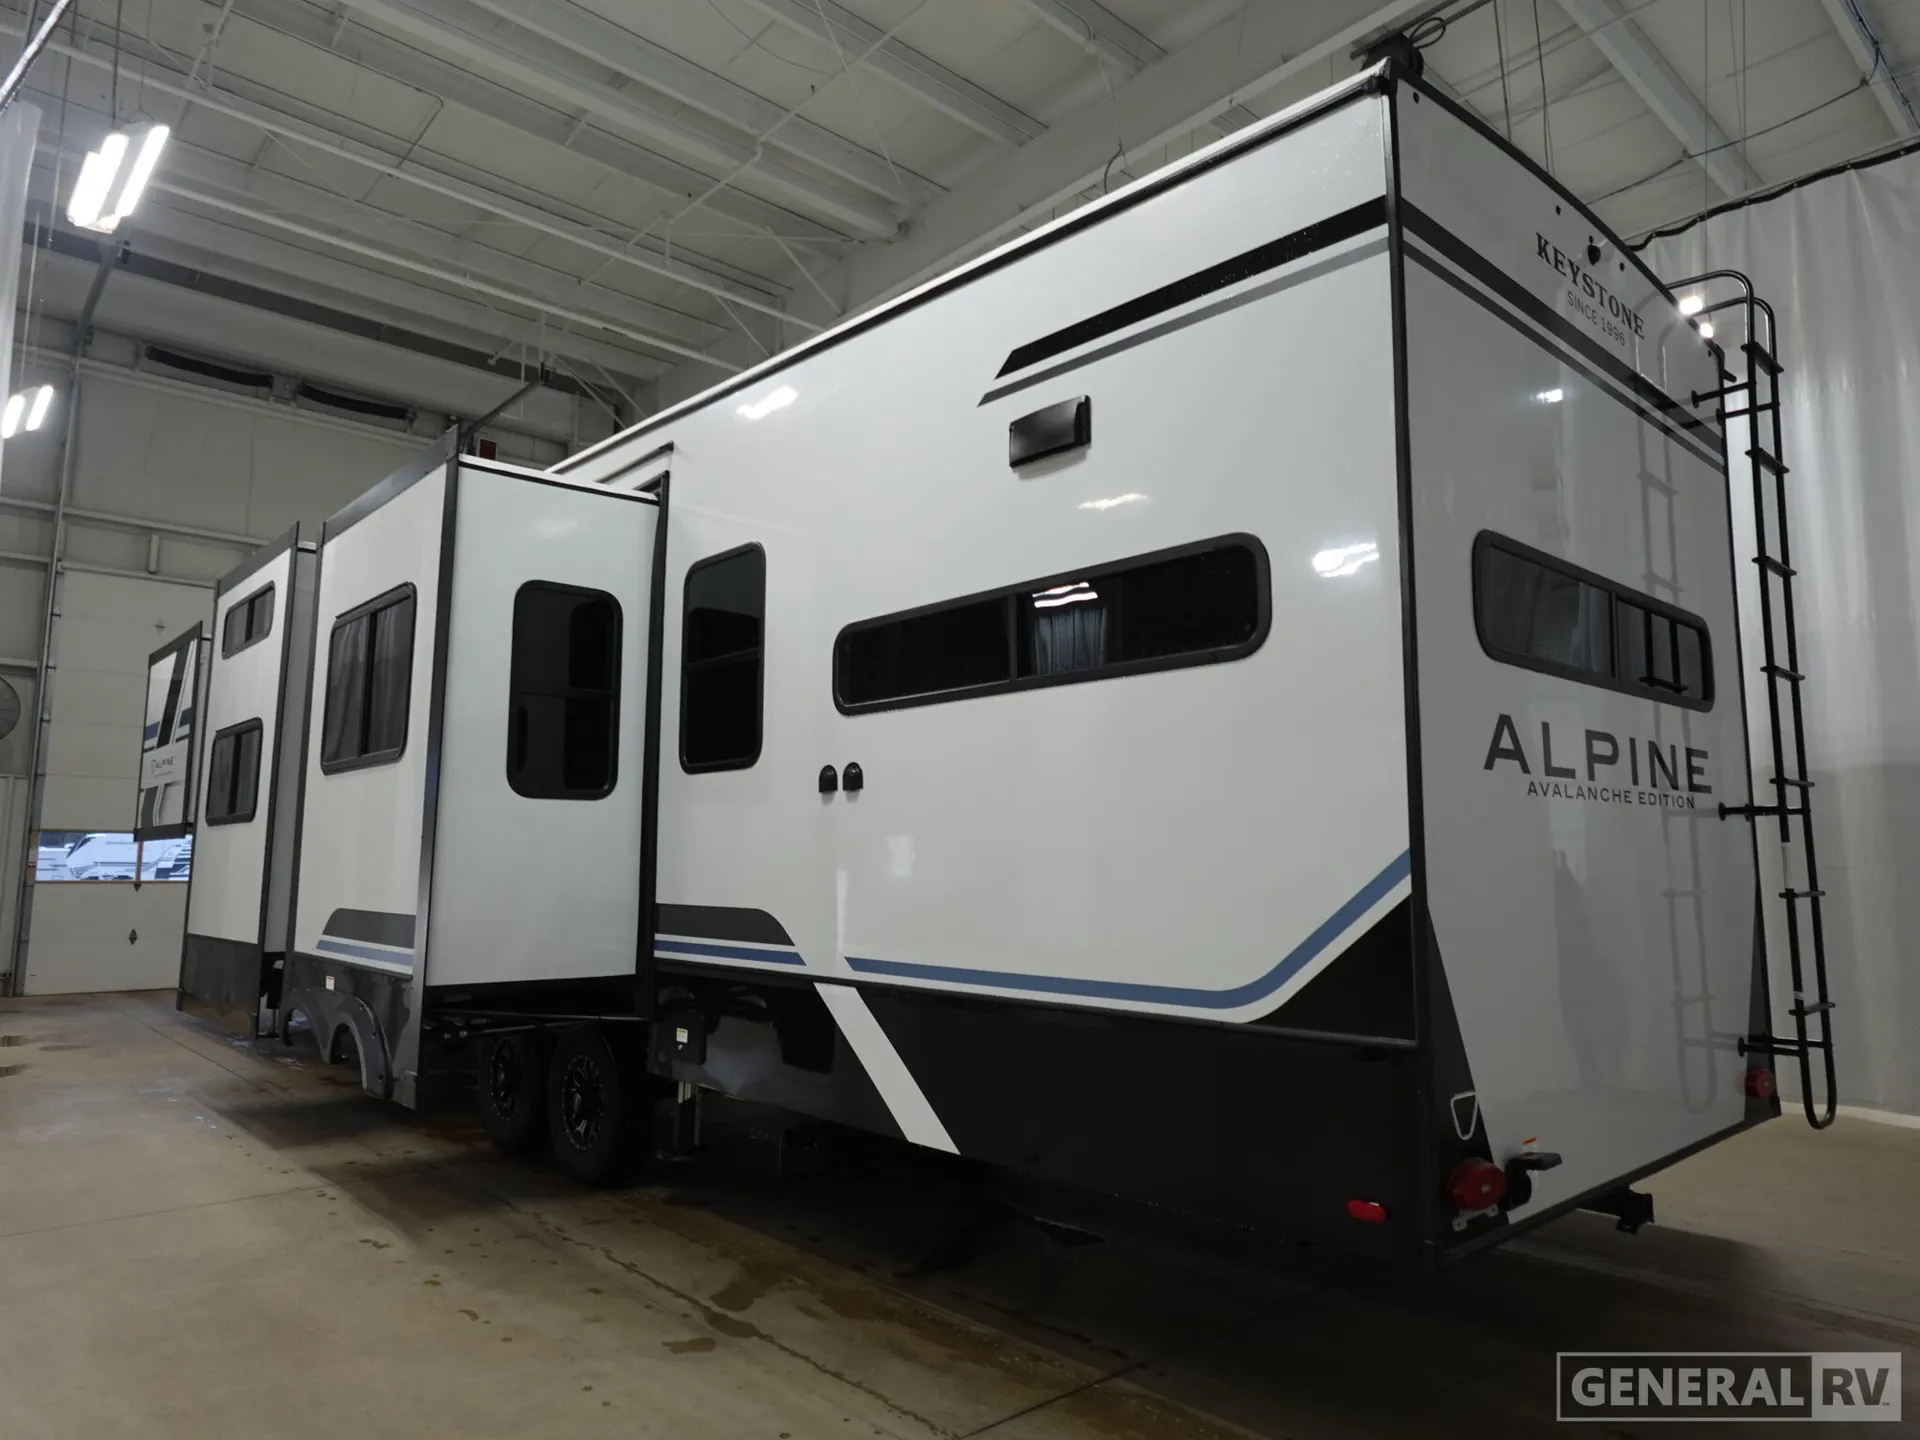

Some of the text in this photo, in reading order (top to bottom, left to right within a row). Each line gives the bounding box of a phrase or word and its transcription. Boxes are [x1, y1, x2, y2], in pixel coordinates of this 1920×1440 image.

[1536, 232, 1645, 340] KEYSTONE
[1567, 290, 1626, 346] SINCE 1996
[1483, 713, 1712, 794] ALPINE
[1527, 780, 1695, 809] AVALANCHE EDITION
